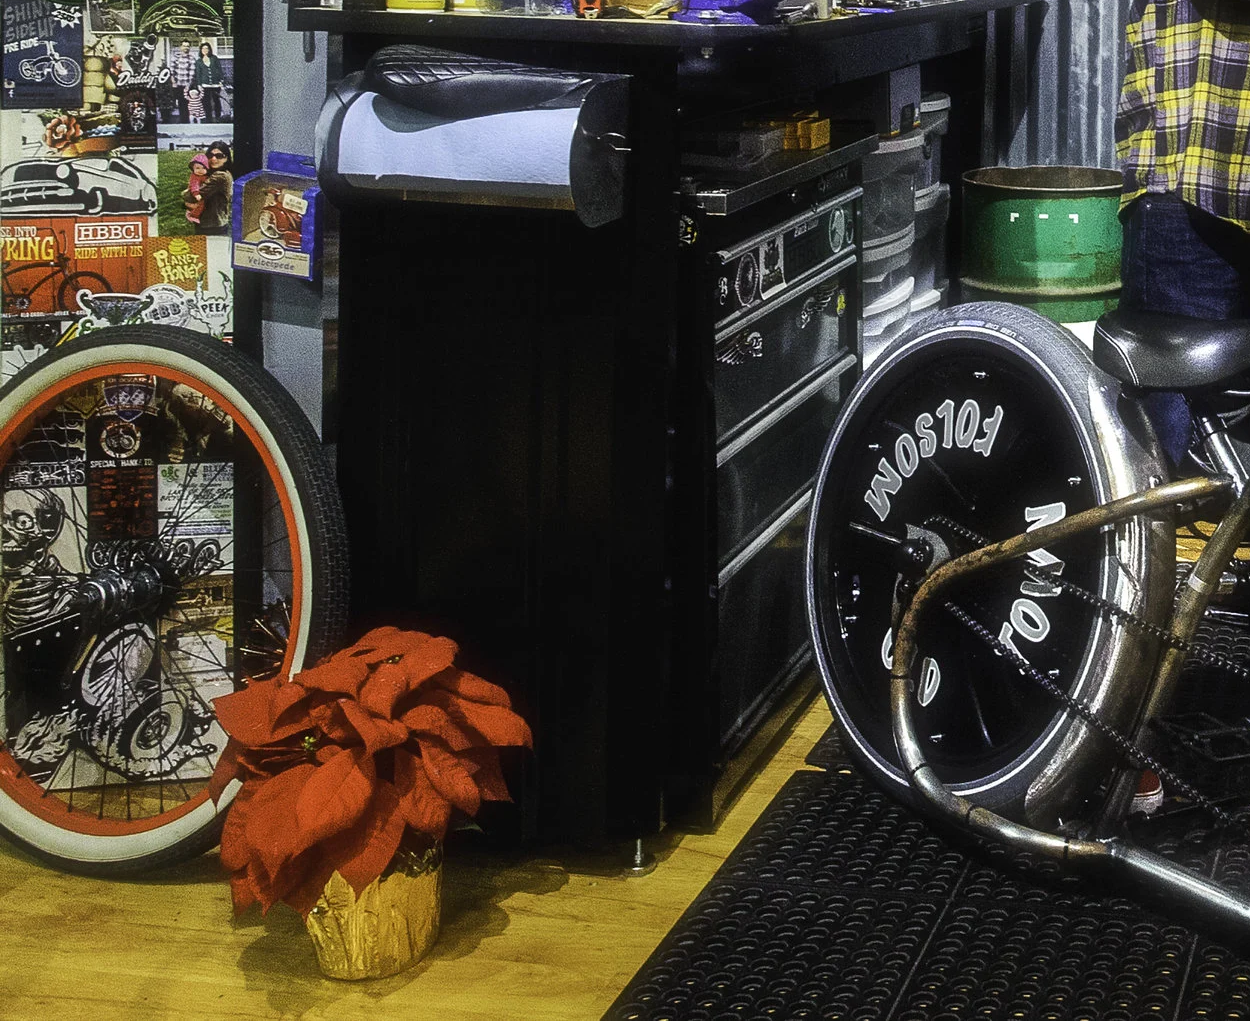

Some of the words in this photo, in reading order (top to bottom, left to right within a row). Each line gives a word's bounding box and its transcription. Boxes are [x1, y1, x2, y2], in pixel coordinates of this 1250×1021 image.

[4, 0, 52, 25] SHINY
[5, 21, 37, 42] SIDE
[14, 226, 37, 238] INTO
[75, 247, 98, 259] RIDE
[102, 246, 127, 258] WITH
[130, 246, 144, 257] US
[153, 249, 200, 267] PLANET
[160, 262, 204, 284] HONEY
[201, 302, 230, 314] PEEK
[90, 460, 117, 468] SPECIAL
[864, 399, 1004, 522] FOLSOM
